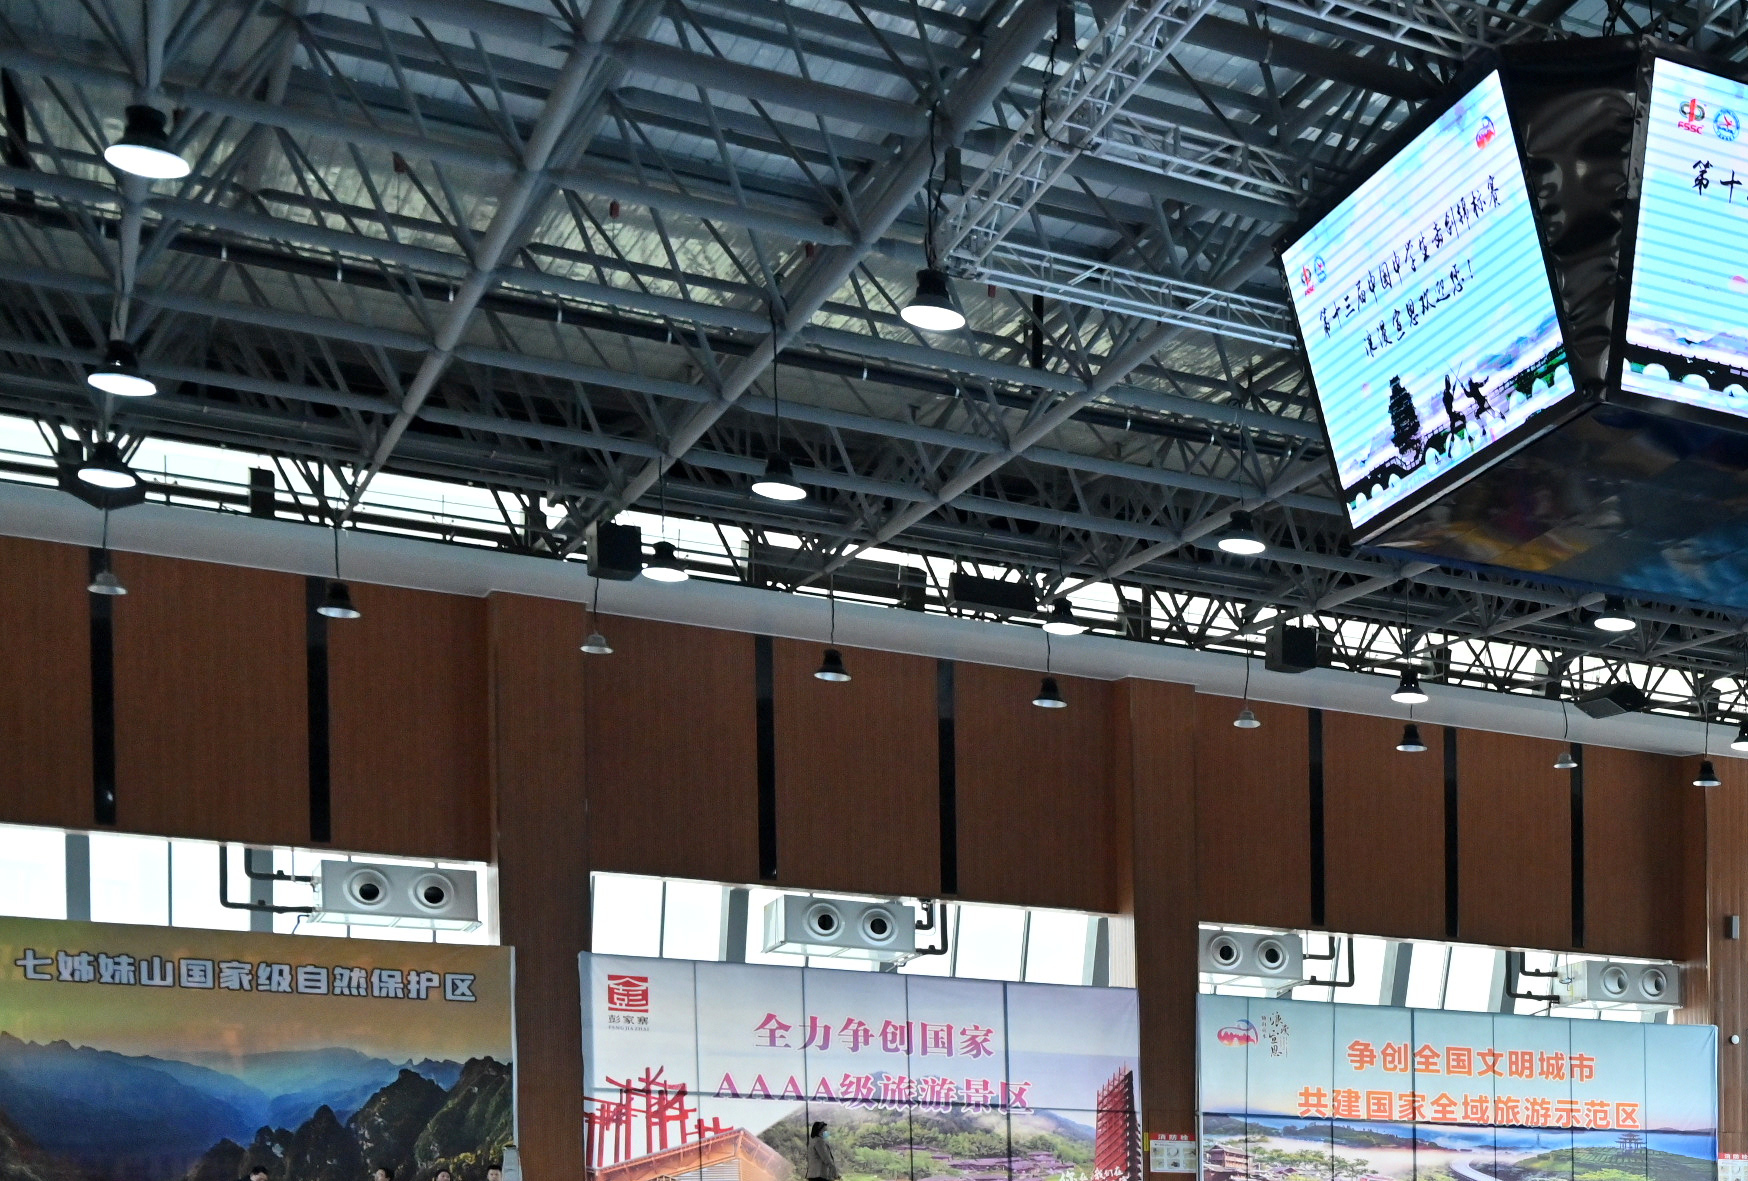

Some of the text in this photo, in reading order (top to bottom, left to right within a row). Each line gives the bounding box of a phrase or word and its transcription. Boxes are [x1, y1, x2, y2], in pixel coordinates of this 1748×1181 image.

[1319, 175, 1500, 338] 第十三届中国中学生击剑锦标赛
[15, 948, 477, 1002] 七姊妹山国家级自然保护区
[754, 1012, 995, 1060] 全力争创国家
[1346, 1040, 1596, 1082] 争创全国文明城市
[712, 1072, 1034, 1115] AAAA级旅游景区
[1297, 1086, 1641, 1130] 共建国家全域旅游示范区
